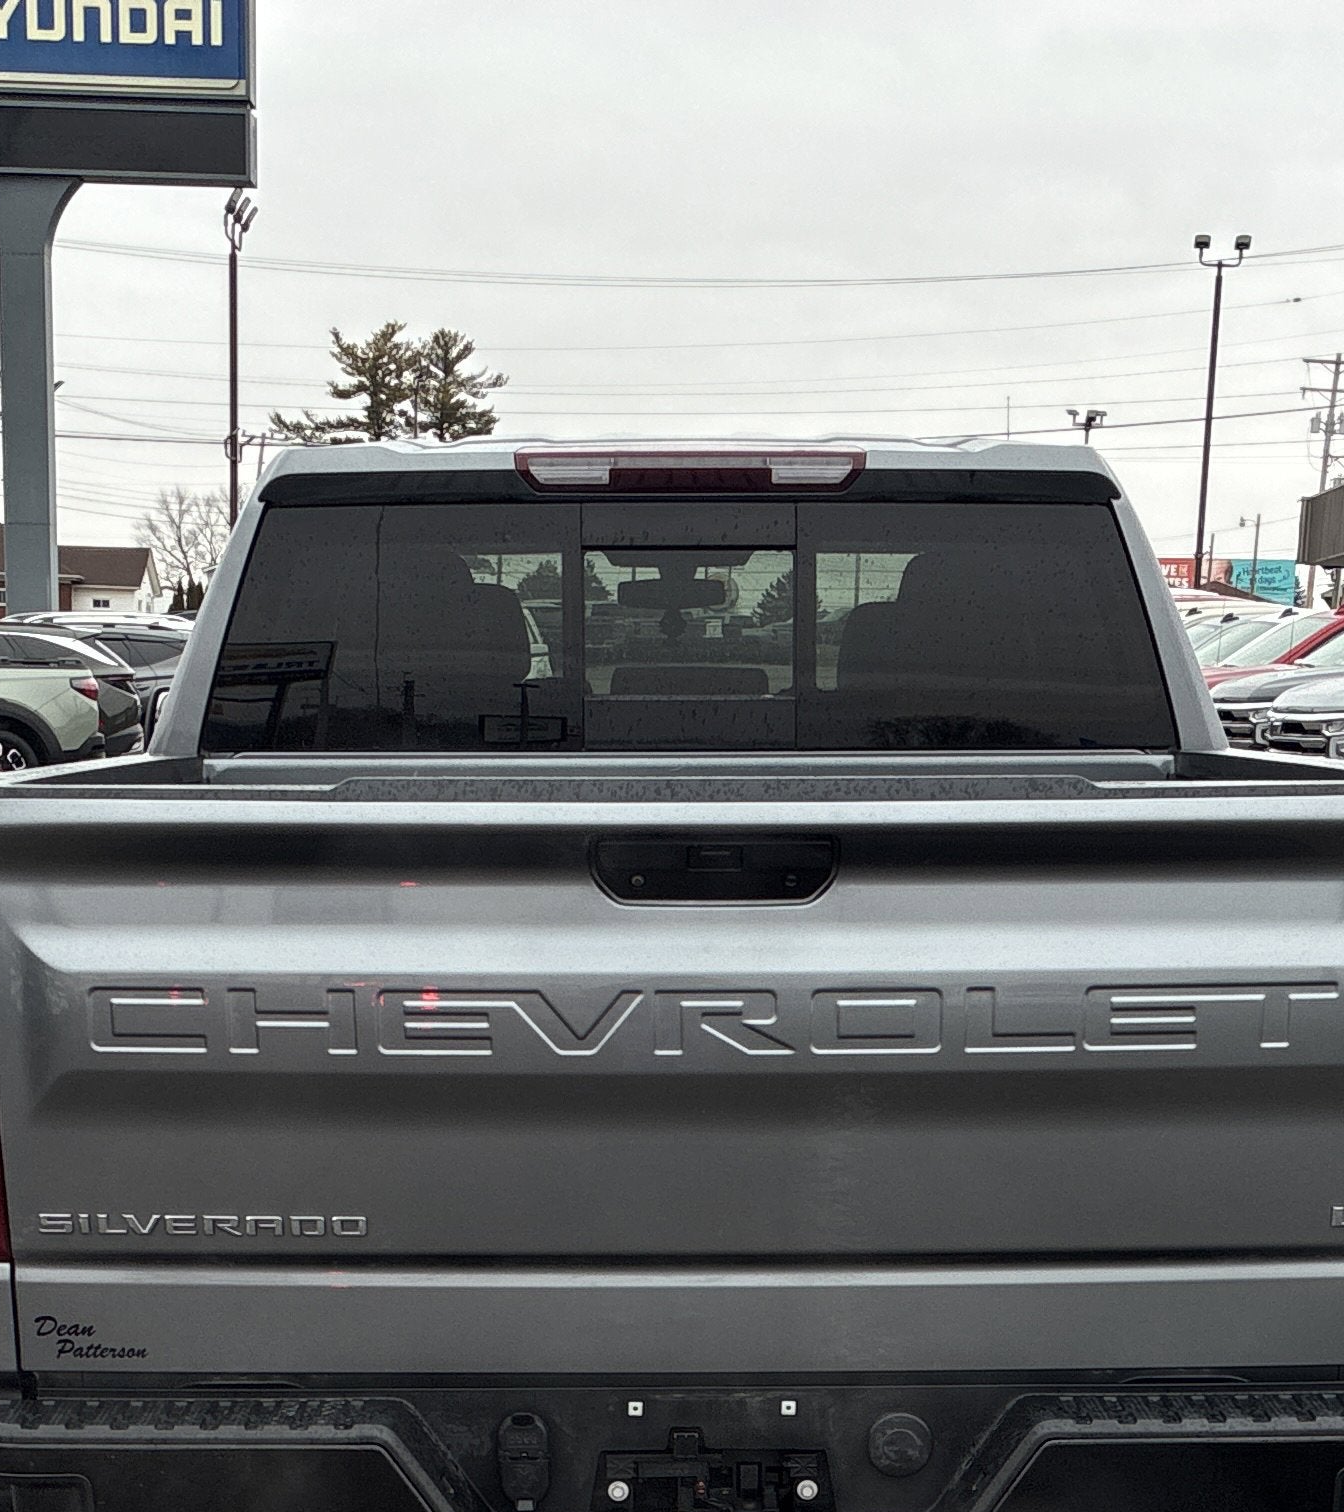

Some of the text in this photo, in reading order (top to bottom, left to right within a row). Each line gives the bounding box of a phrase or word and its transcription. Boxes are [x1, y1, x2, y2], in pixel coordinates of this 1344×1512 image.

[86, 983, 1340, 1056] CHEVROLET
[37, 1212, 369, 1237] SILVERADO
[33, 1315, 97, 1338] Dean
[54, 1337, 149, 1360] Patterson
